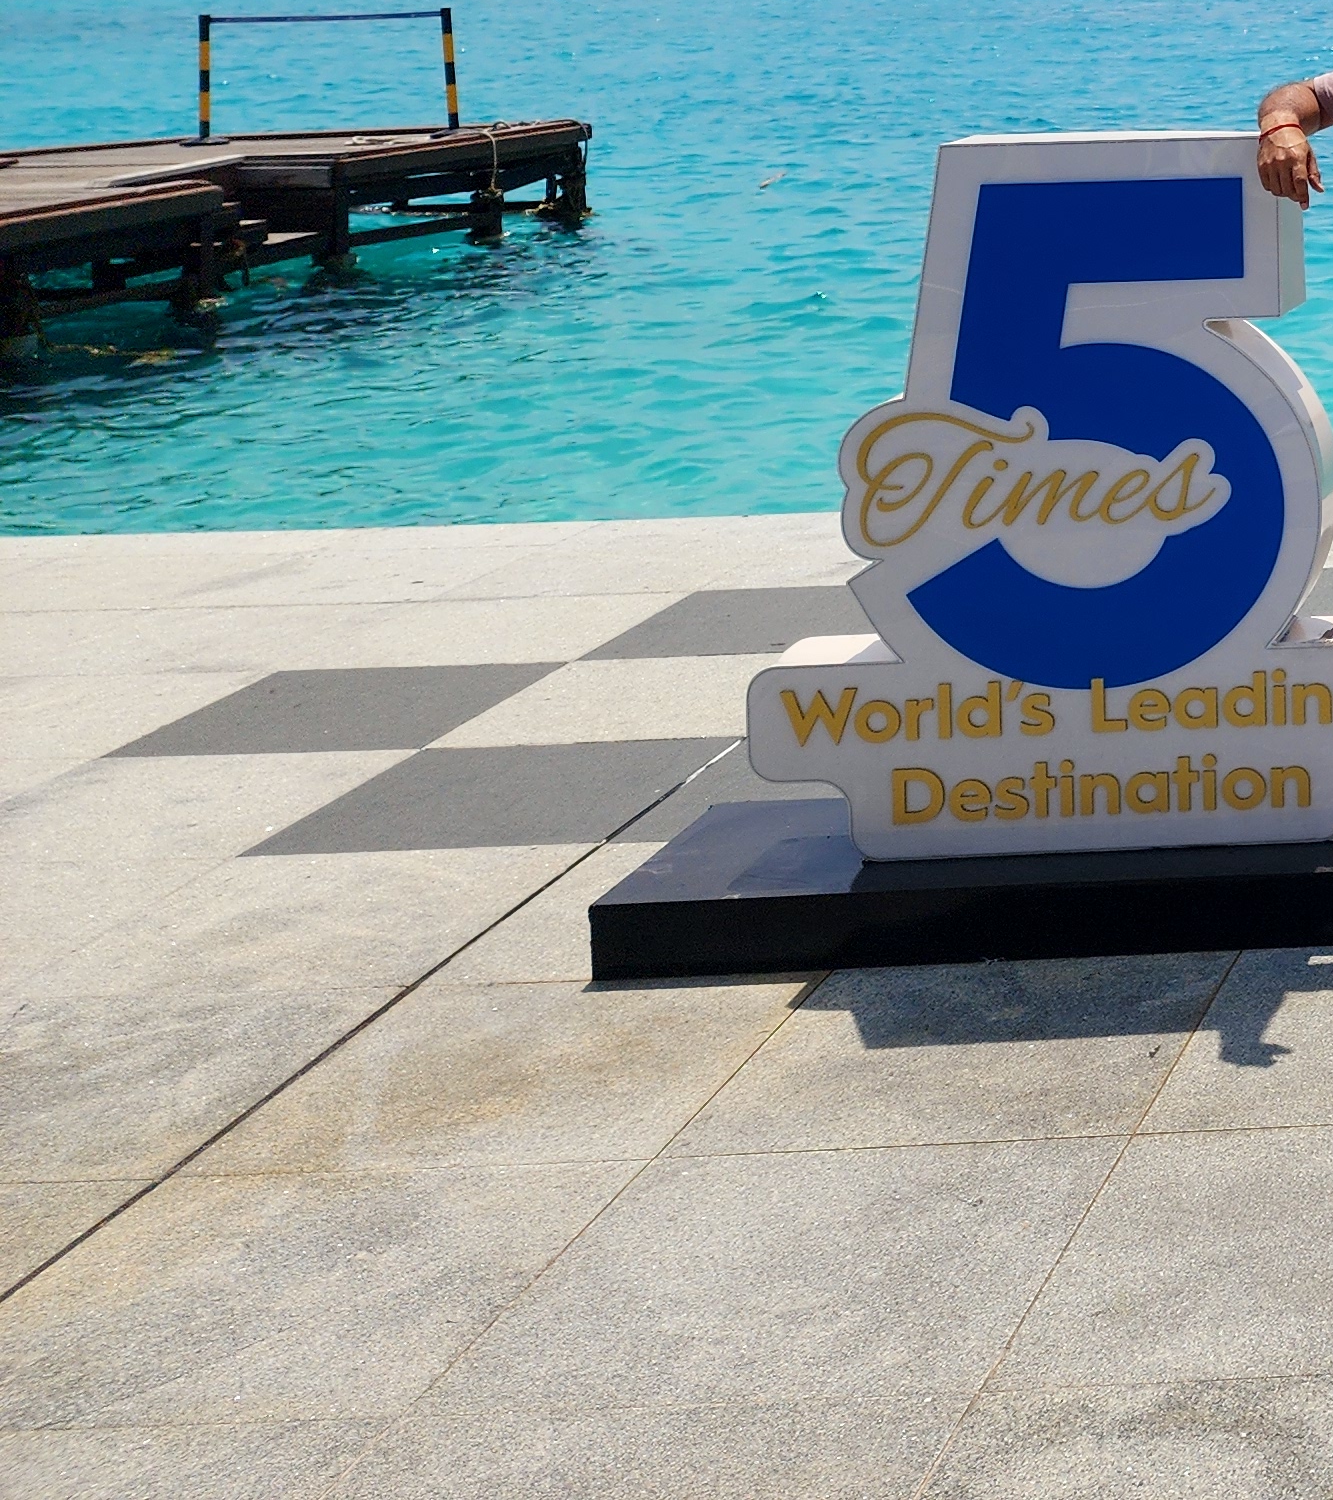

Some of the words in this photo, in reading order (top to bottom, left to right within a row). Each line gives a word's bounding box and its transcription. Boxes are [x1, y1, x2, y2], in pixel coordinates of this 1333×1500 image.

[856, 411, 1217, 548] Times
[907, 177, 1286, 690] 5
[780, 680, 1056, 748] World's
[891, 753, 1312, 826] Destination
